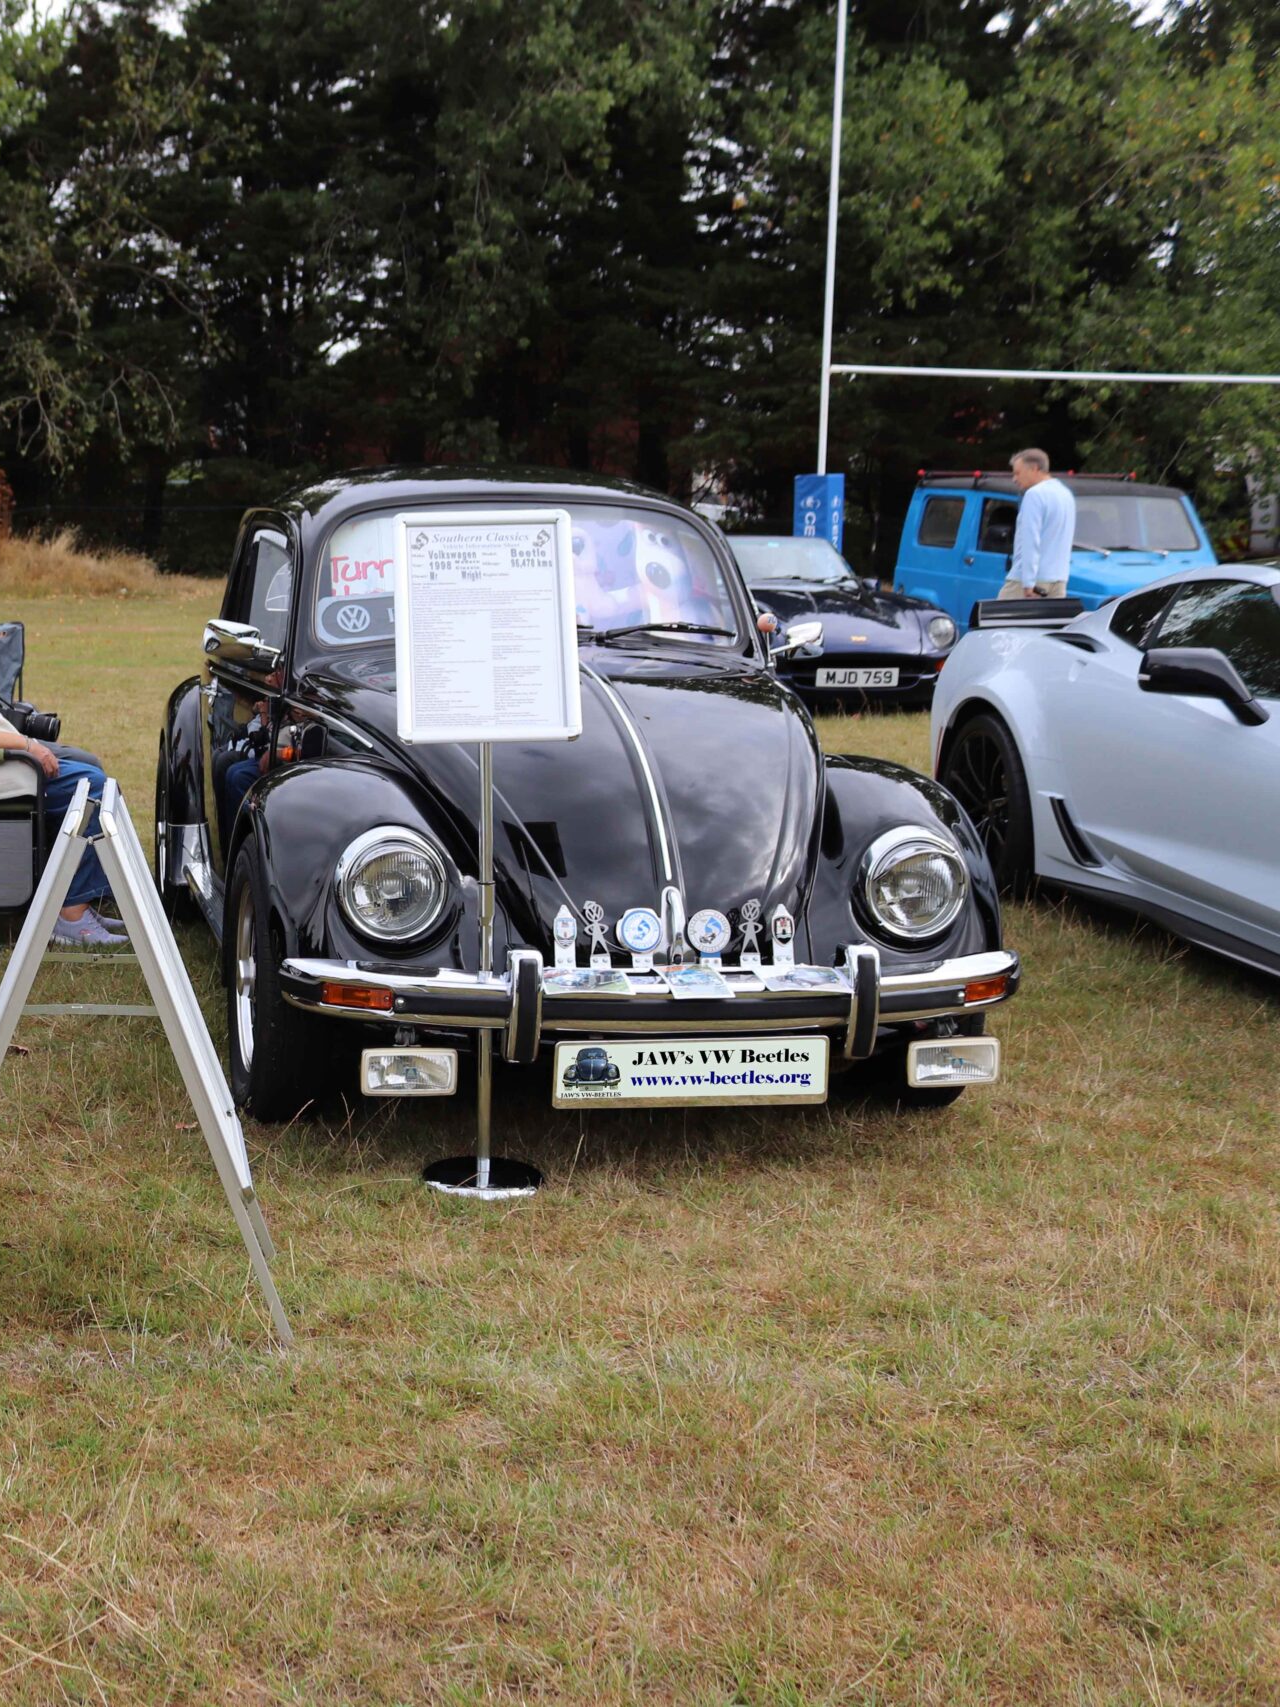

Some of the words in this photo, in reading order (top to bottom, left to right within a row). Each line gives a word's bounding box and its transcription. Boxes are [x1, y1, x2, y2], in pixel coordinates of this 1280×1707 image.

[432, 533, 483, 543] Southern
[486, 532, 530, 542] Classics
[428, 550, 477, 560] Volkswagen
[511, 548, 546, 558] Beetle
[461, 571, 482, 581] Wright
[337, 605, 370, 632] VW
[826, 671, 858, 685] MJD
[863, 671, 893, 684] 759
[699, 1049, 735, 1065] VW
[740, 1048, 810, 1064] Beetles
[630, 1070, 812, 1088] www.vw-beetles.org
